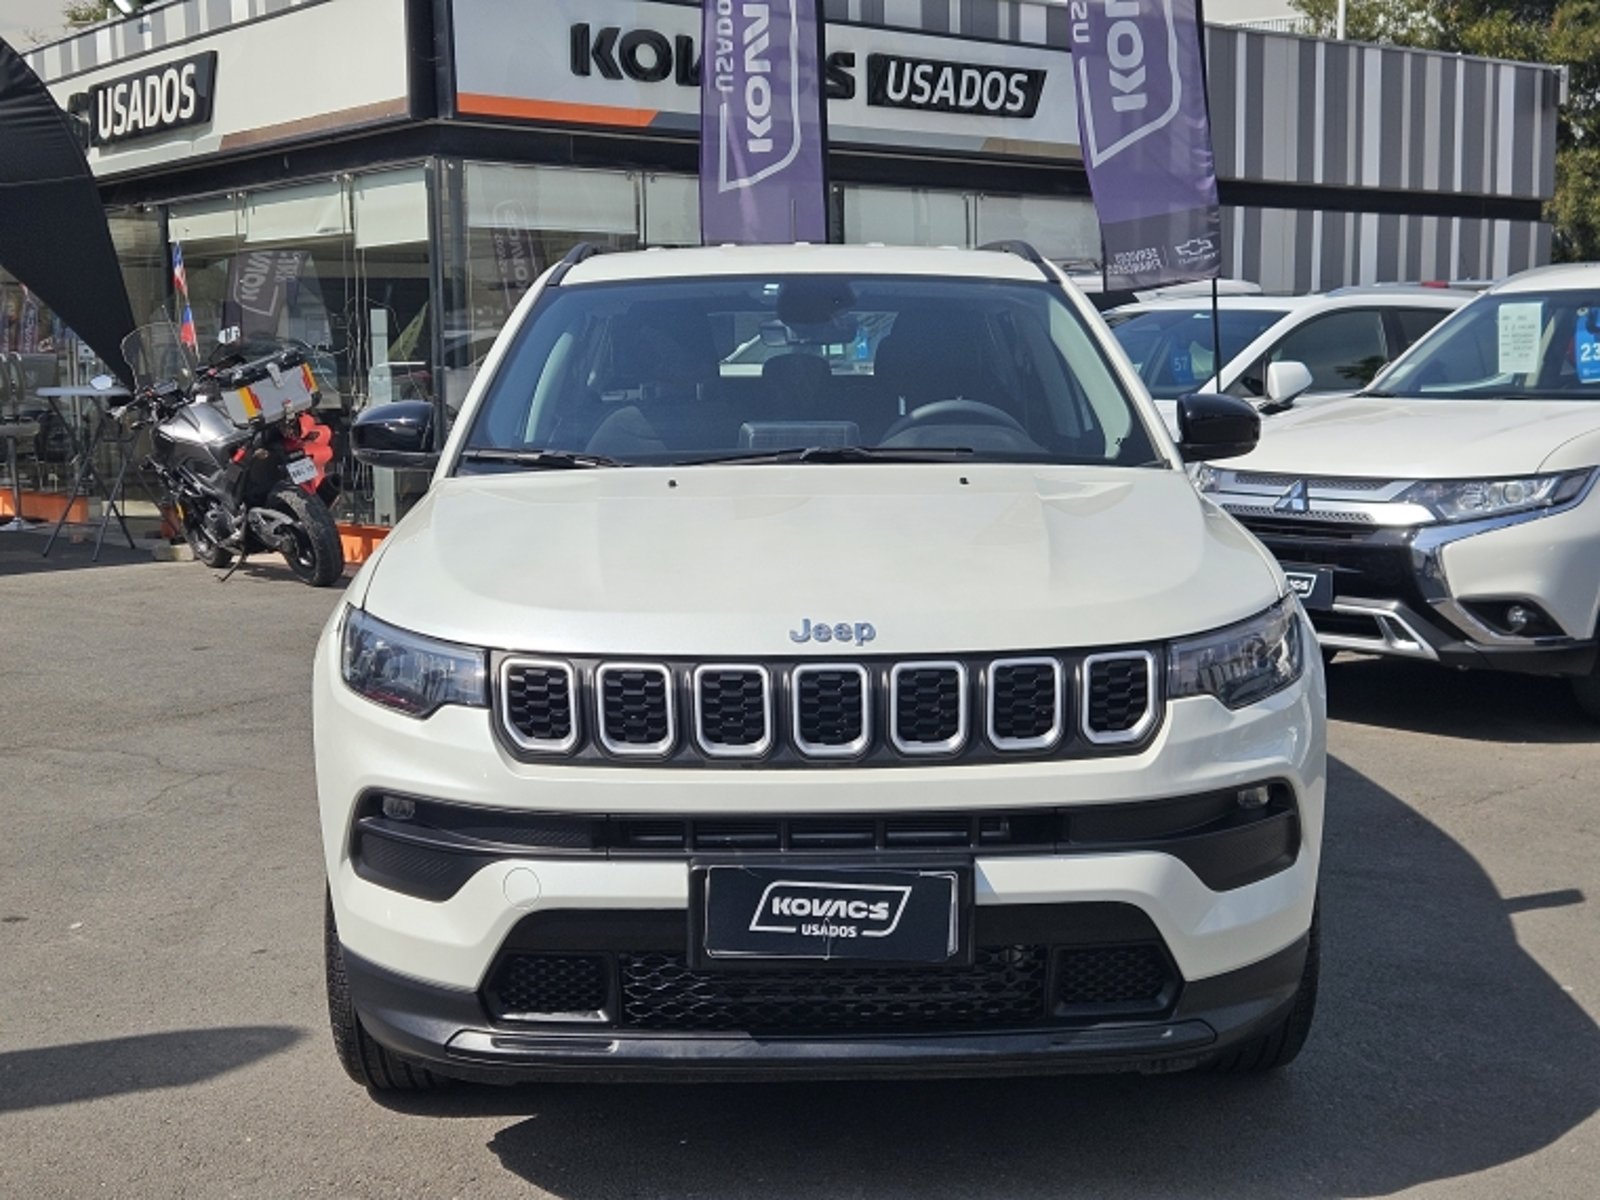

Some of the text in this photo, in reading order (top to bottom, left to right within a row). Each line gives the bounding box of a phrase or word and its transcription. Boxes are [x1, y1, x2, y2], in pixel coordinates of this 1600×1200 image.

[886, 60, 1029, 112] USADOS
[98, 62, 196, 140] USADOS
[789, 618, 877, 647] Jeep
[772, 896, 890, 920] KOVACS
[801, 923, 858, 938] USADOS
